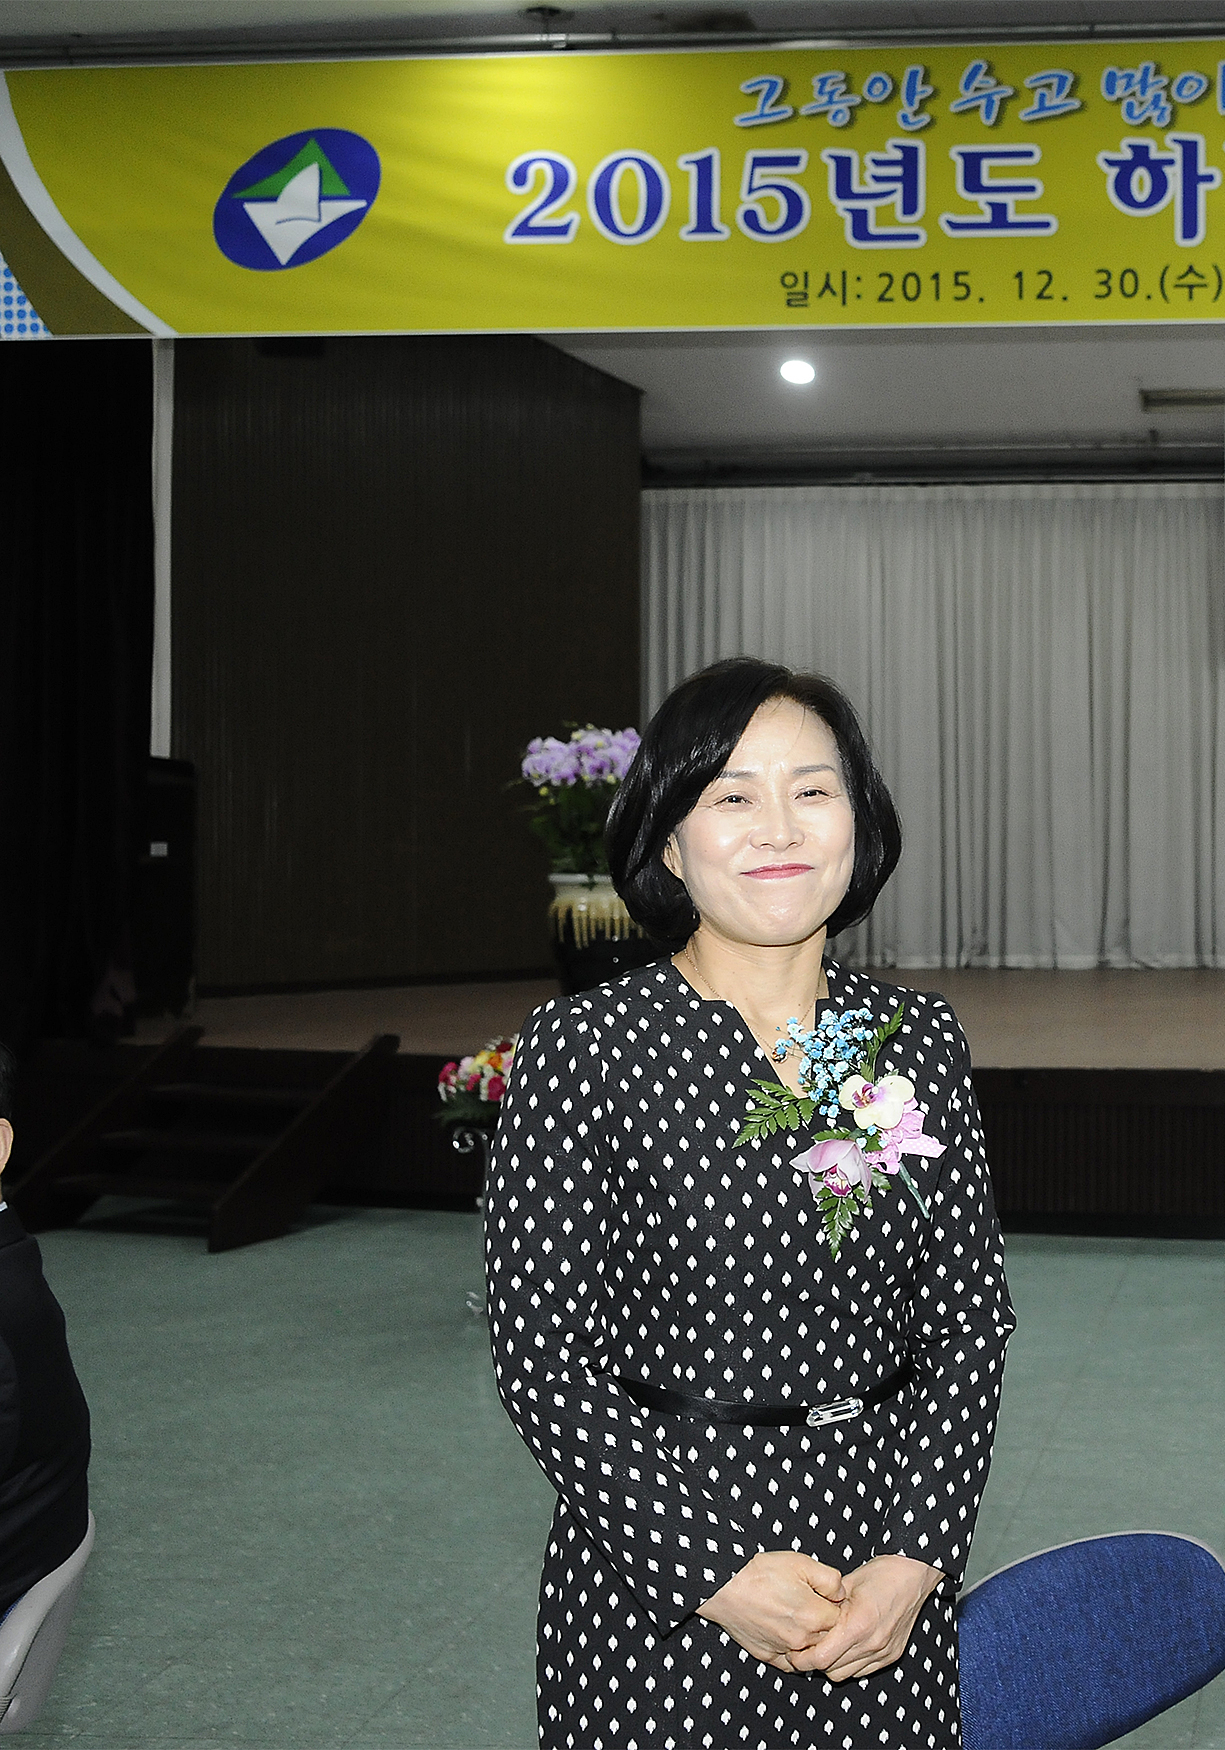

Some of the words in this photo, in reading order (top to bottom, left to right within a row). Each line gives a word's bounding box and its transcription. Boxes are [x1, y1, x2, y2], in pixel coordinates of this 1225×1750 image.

[736, 67, 930, 129] 그동안
[952, 61, 1079, 123] 수고
[507, 139, 1056, 246] 2015년도
[779, 270, 863, 309] 일시:
[876, 270, 985, 305] 2015.
[1013, 268, 1069, 302] 12.
[1093, 263, 1224, 304] 30.(수)
